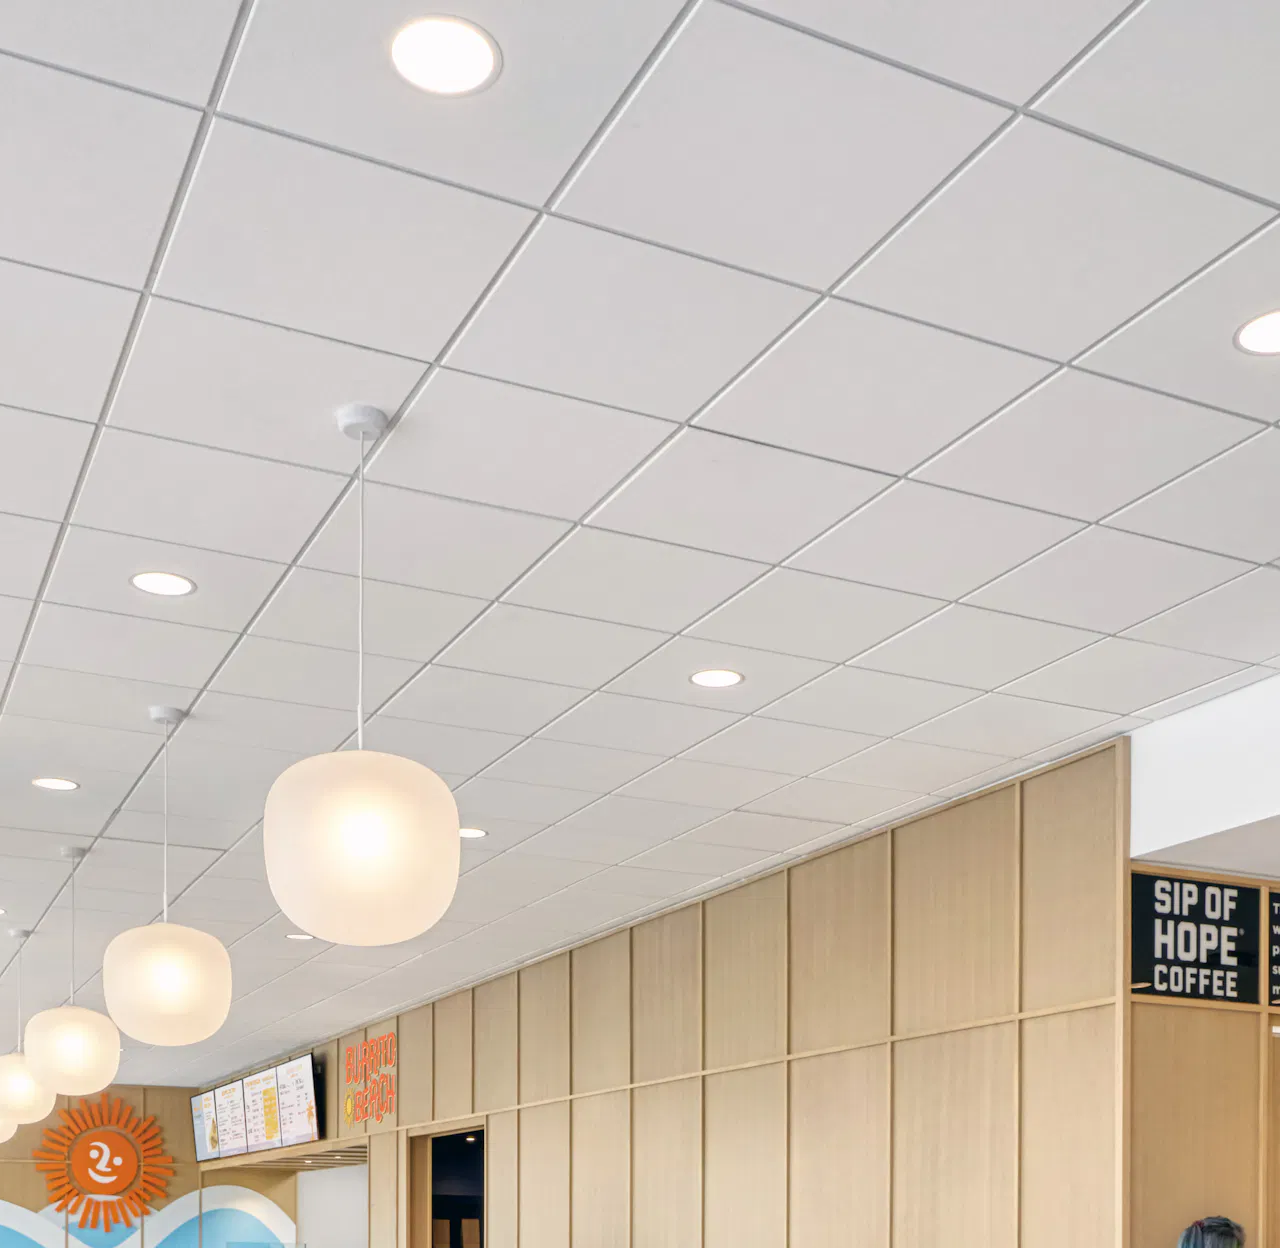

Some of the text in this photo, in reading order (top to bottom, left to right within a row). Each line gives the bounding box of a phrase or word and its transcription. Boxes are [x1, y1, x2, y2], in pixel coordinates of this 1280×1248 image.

[1154, 880, 1238, 921] SIP OF
[1154, 919, 1238, 966] HOPE
[1154, 964, 1238, 997] COFFEE
[345, 1032, 396, 1084] BURRITO
[355, 1073, 395, 1122] BEACH
